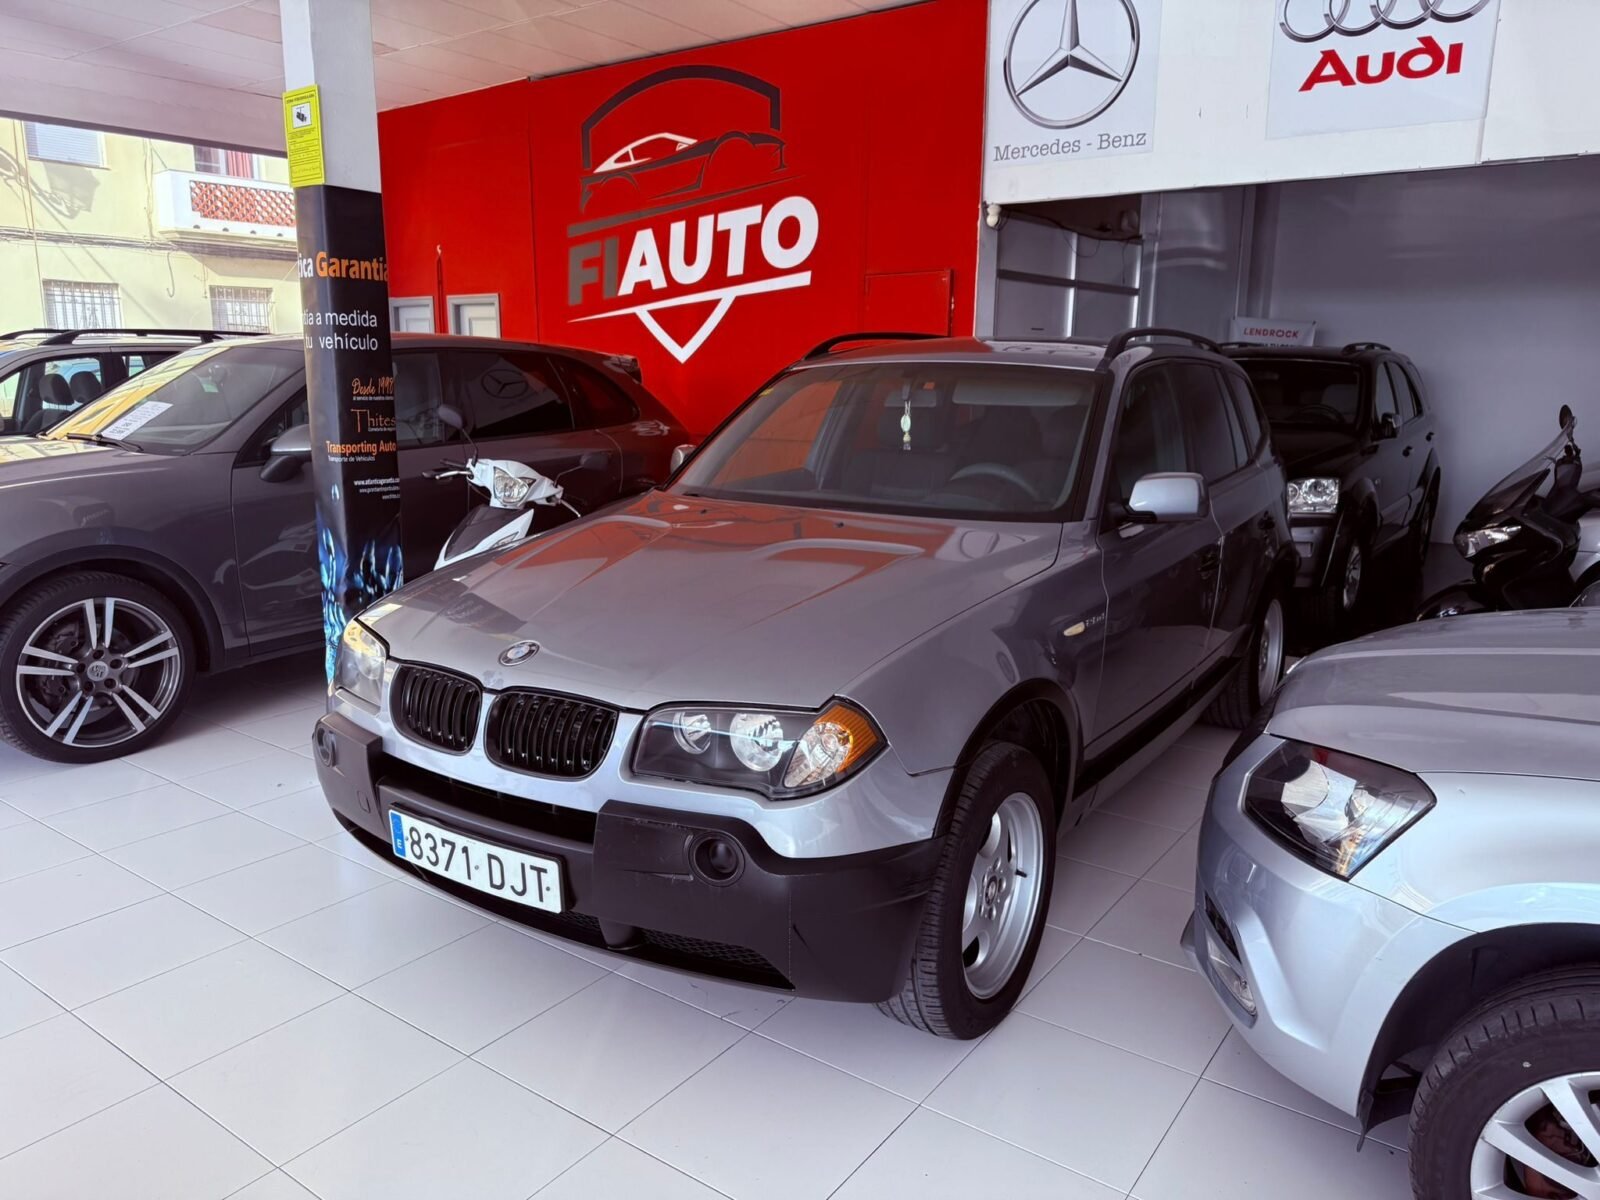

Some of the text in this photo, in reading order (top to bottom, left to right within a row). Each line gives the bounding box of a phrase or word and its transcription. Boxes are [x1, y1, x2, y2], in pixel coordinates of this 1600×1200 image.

[1298, 36, 1463, 92] Audi
[993, 139, 1081, 161] Mercedes
[1097, 132, 1147, 150] Benz
[315, 311, 322, 325] a
[325, 309, 378, 327] medida
[318, 332, 379, 350] vehículo
[1243, 327, 1299, 338] LENDROCK
[351, 377, 376, 395] Desde
[350, 409, 397, 432] Thites
[326, 440, 397, 456] Transporting Auto
[409, 826, 548, 902] 8371 DJT
